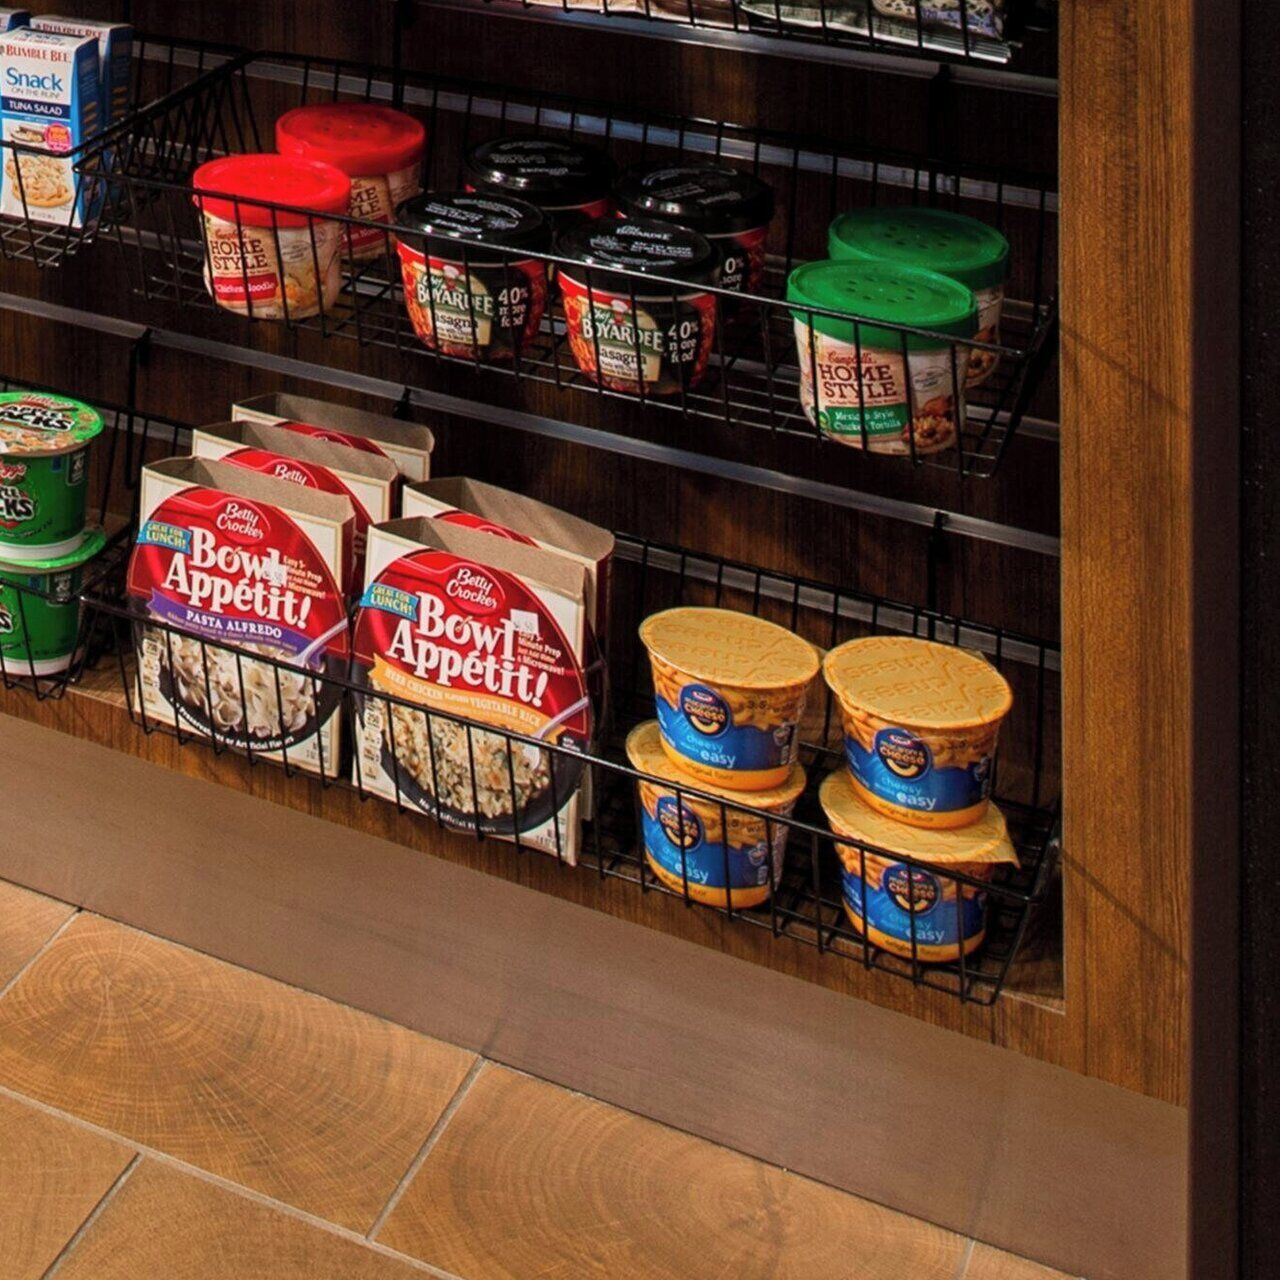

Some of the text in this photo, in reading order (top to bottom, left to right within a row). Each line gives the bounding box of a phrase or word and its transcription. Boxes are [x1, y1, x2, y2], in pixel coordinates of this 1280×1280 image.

[5, 44, 70, 63] BUMBLE BEE
[6, 66, 63, 92] Snack
[9, 99, 63, 117] TUNA SALAD
[210, 239, 265, 256] HOME
[211, 254, 269, 271] STYLE
[818, 363, 894, 382] HOME
[823, 380, 898, 399] STYLE
[226, 502, 259, 526] Betty
[216, 513, 264, 539] Crocker
[146, 530, 187, 549] LUNCH!
[187, 525, 288, 588] Bowl
[161, 552, 313, 630] Appétit!
[457, 567, 493, 593] Betty
[370, 593, 415, 616] LUNCH!
[445, 579, 498, 610] Crocker
[186, 609, 283, 640] PASTA ALFREDO
[414, 590, 519, 663] Bowl
[385, 618, 550, 708] Appétit!
[699, 749, 737, 770] easy
[895, 791, 938, 812] easy
